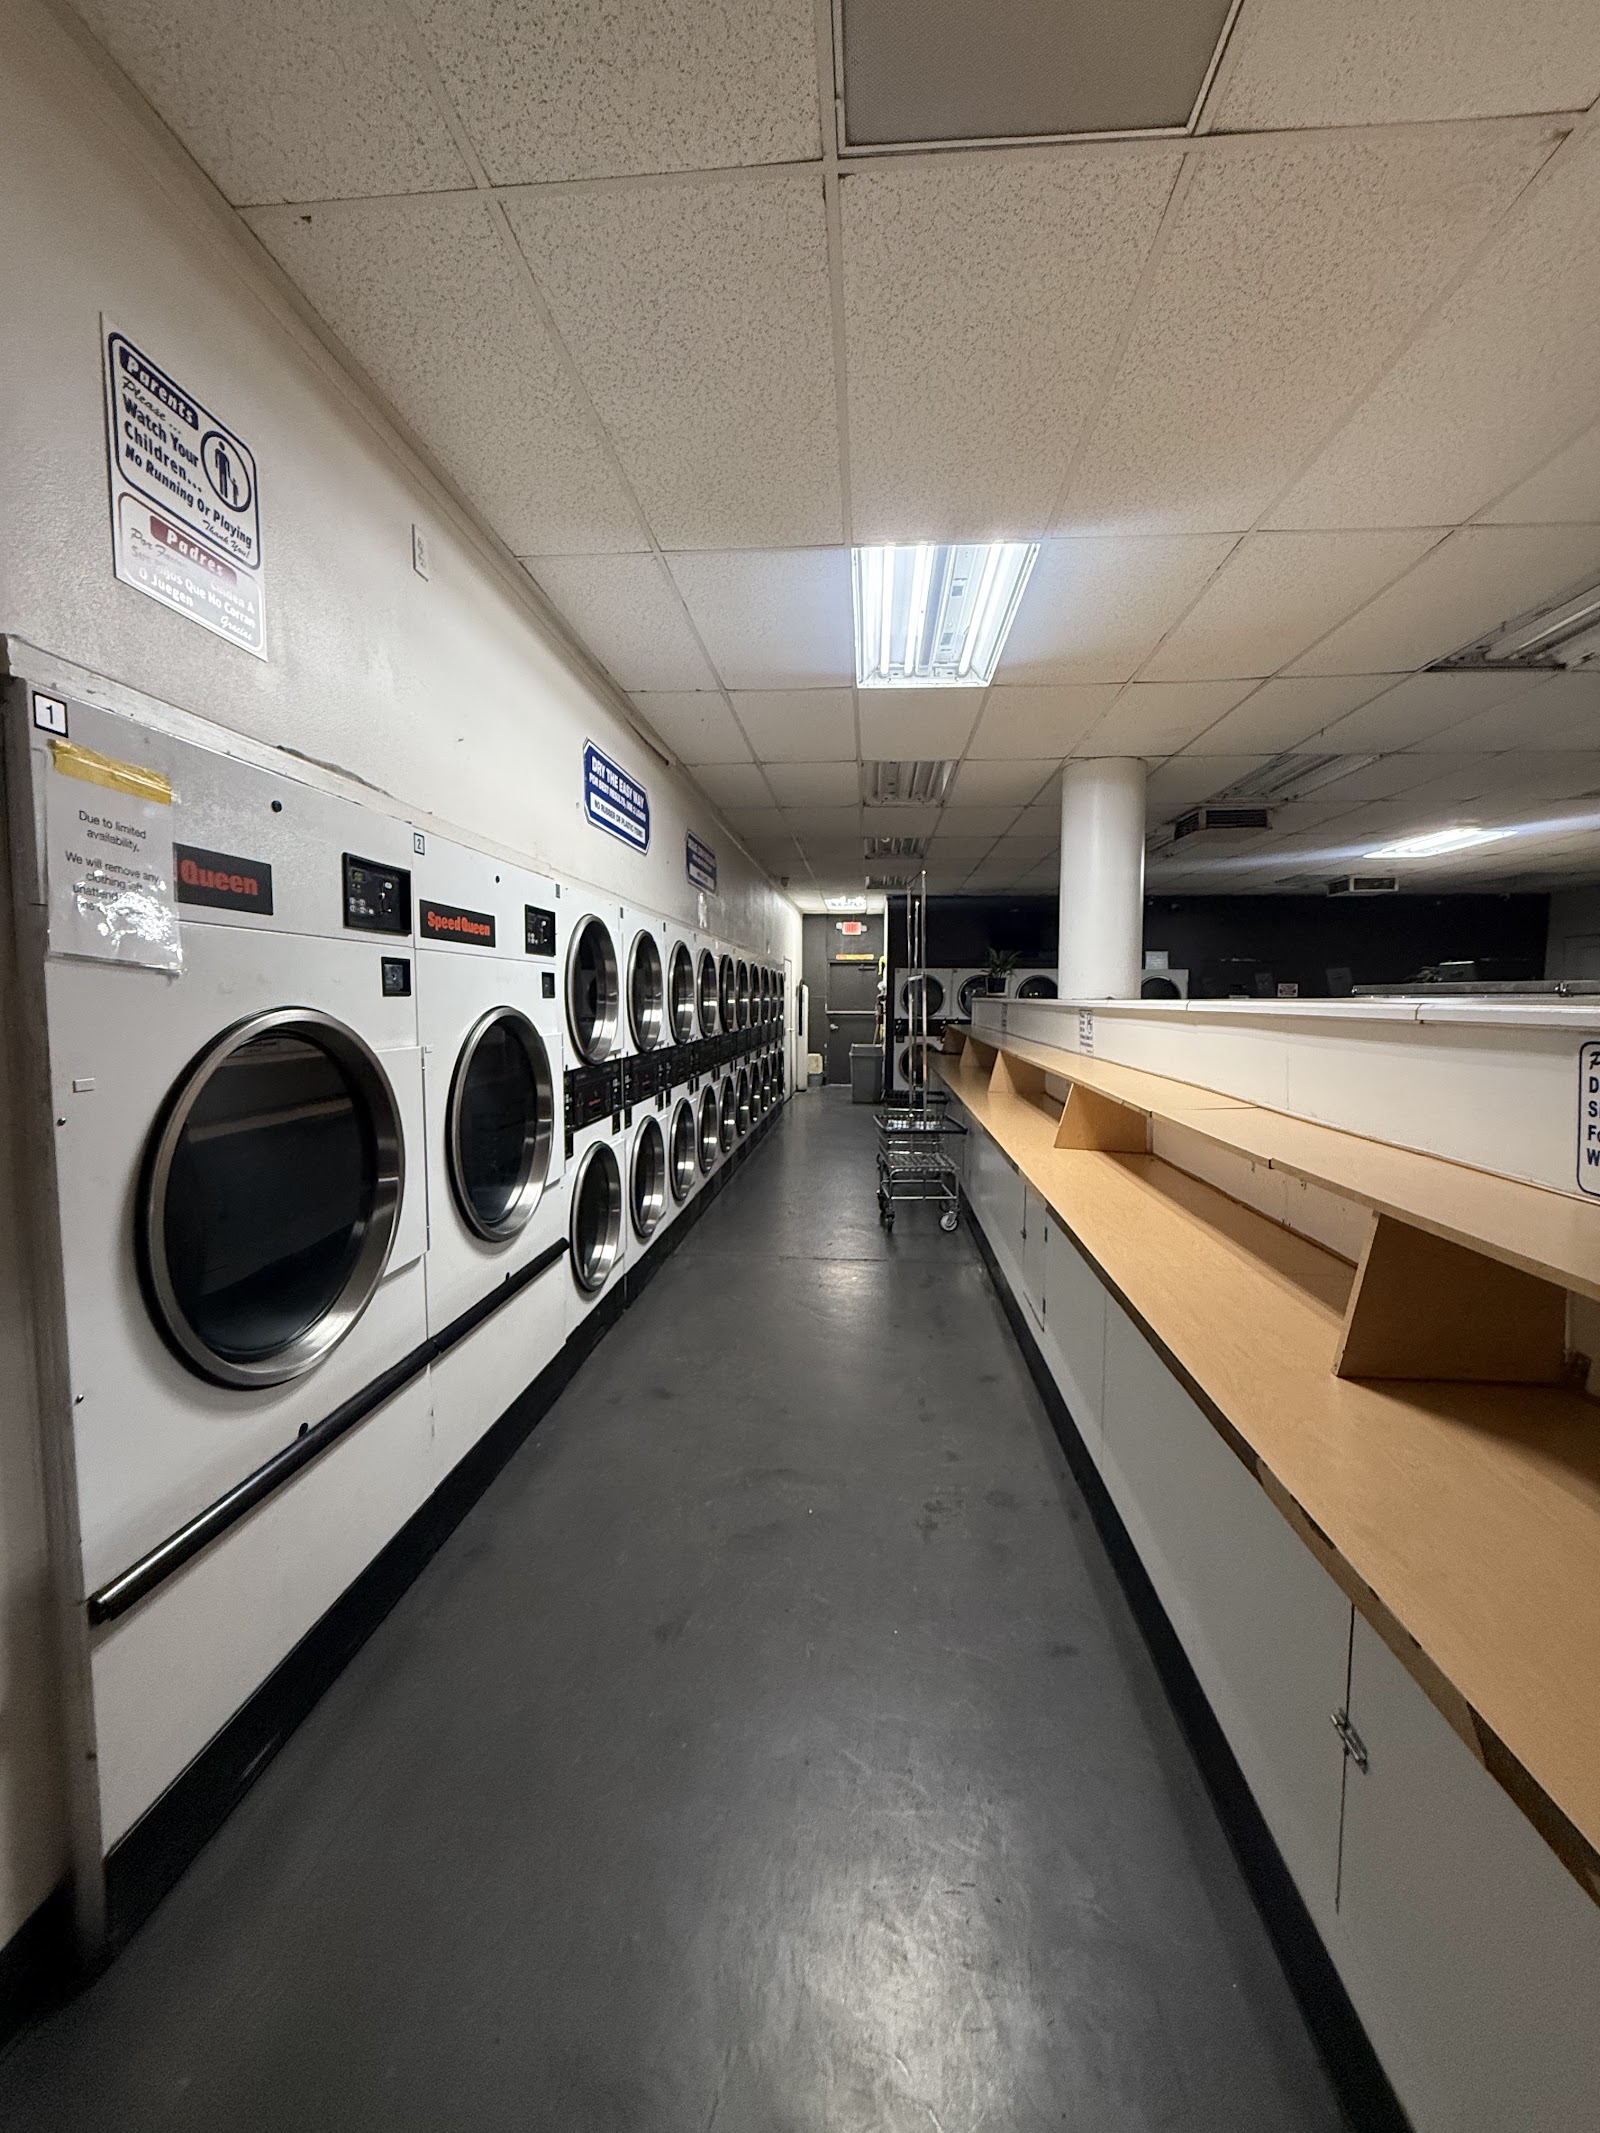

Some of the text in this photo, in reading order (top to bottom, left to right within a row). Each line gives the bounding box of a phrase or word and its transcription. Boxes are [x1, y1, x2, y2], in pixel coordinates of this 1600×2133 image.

[122, 375, 166, 421] Please
[127, 356, 193, 423] Parents
[122, 393, 199, 467] Watch Your
[125, 443, 252, 549] No Running Or Playing
[166, 529, 224, 577] Padres
[202, 519, 250, 559] Thank You!
[150, 573, 194, 608] Juegen
[185, 576, 206, 600] Que
[207, 590, 222, 609] No
[223, 601, 256, 629] Corran
[210, 580, 244, 608] Cden
[247, 601, 255, 615] A
[219, 615, 252, 642] Gracias
[46, 704, 54, 725] 1
[592, 755, 605, 779] DRY
[606, 767, 619, 790] THE
[619, 778, 633, 801] EASY
[79, 809, 147, 839] Due to limited
[87, 829, 140, 852] availability.
[416, 838, 422, 850] 2
[65, 850, 159, 885] We will remove any
[86, 872, 126, 890] clothing
[180, 859, 259, 896] Queen
[427, 911, 490, 937] Speed Queen
